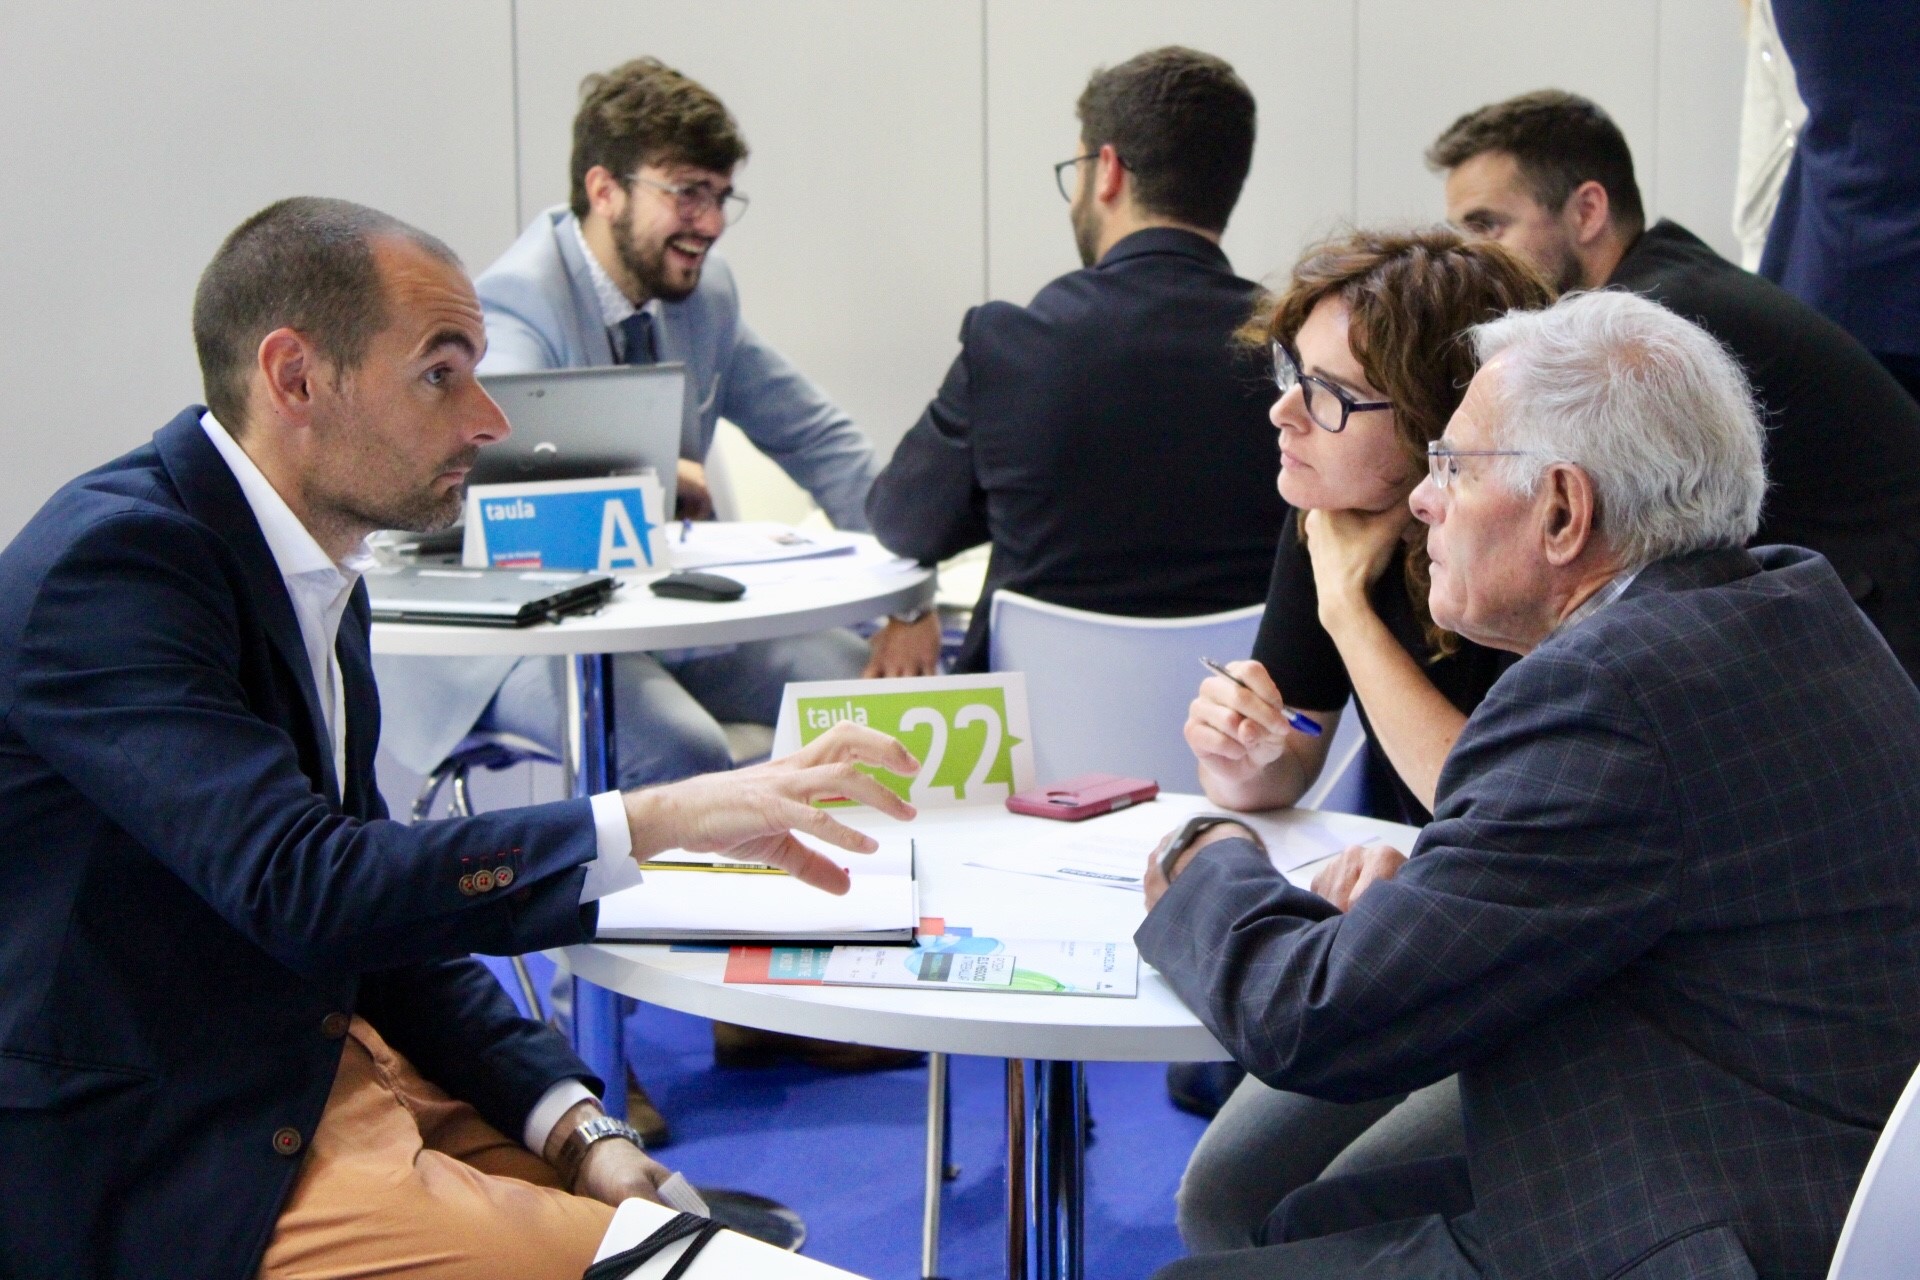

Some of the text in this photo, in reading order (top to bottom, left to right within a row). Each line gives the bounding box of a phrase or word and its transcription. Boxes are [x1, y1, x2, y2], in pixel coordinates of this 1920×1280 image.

[485, 499, 536, 521] taula
[597, 498, 654, 570] A
[807, 701, 869, 730] taula
[899, 703, 1010, 801] 22
